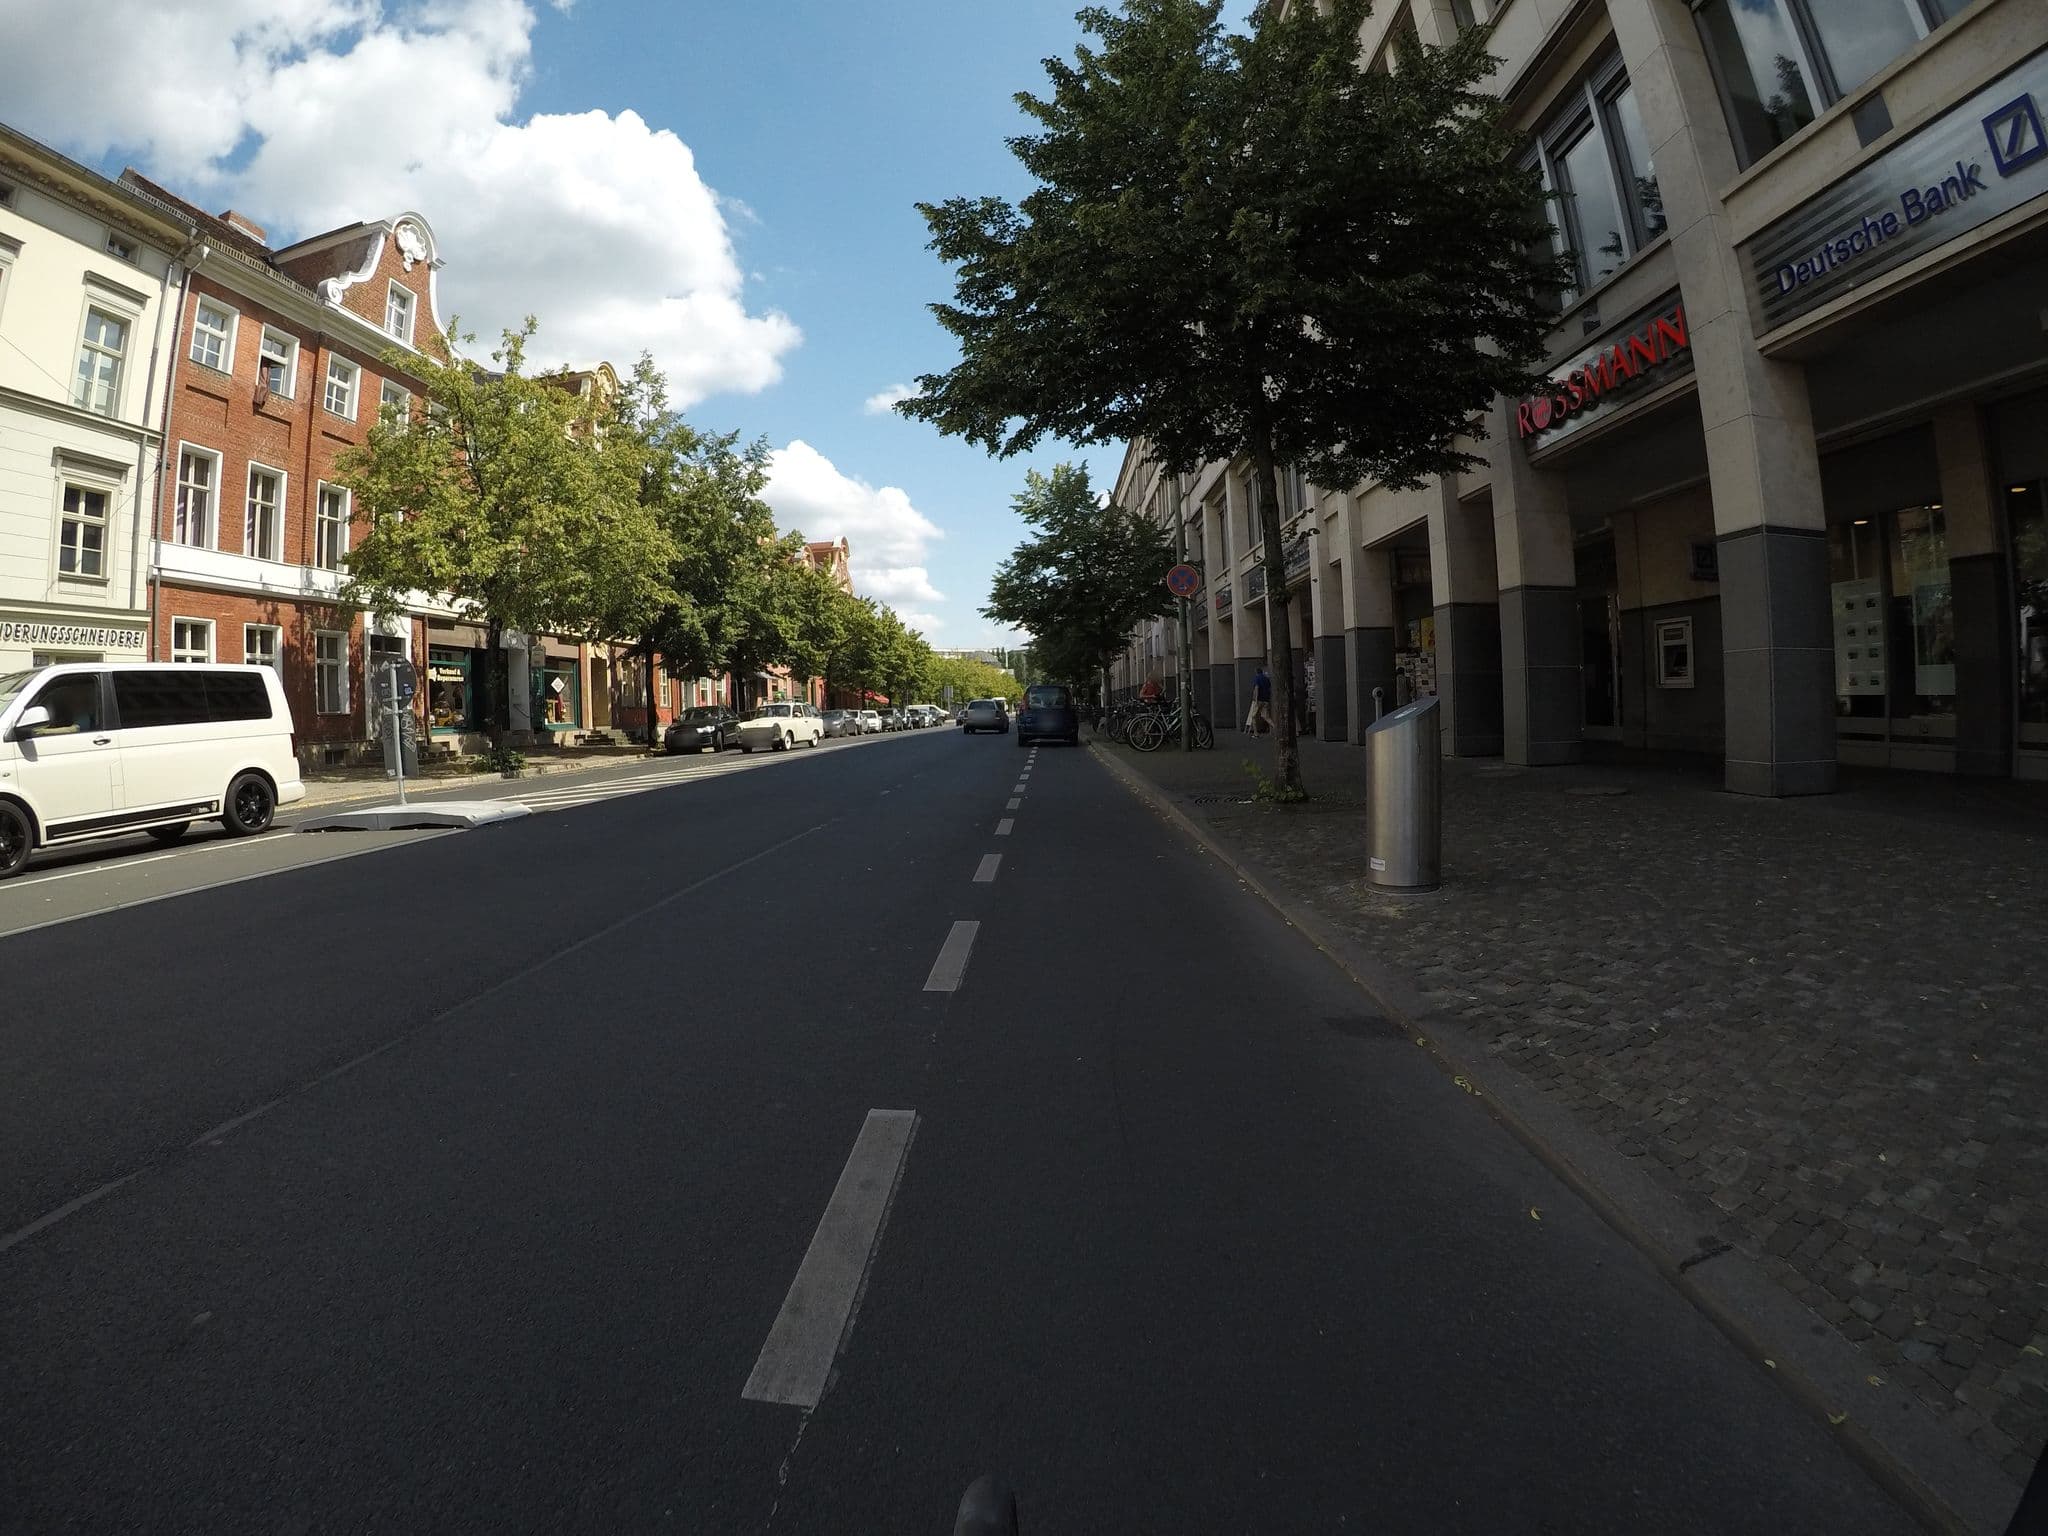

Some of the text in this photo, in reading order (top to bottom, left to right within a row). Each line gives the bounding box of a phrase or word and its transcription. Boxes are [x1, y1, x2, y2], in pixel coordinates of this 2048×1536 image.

[1775, 160, 1989, 295] Deutsche Bank
[1517, 305, 1689, 439] ROSSMANN
